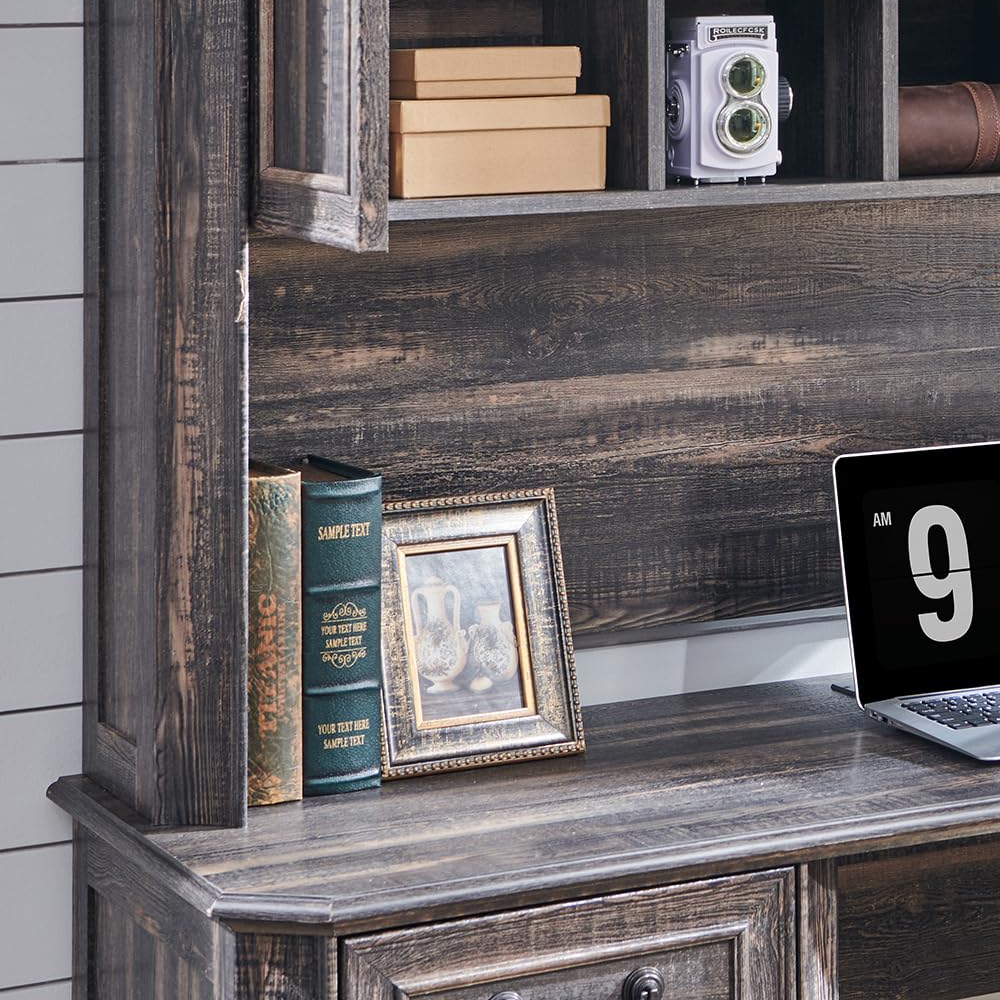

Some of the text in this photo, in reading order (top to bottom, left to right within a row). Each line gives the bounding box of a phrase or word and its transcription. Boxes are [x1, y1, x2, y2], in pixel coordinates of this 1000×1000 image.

[318, 522, 370, 540] SAMPLE TEXT
[873, 511, 892, 528] AM
[907, 504, 974, 642] 9
[321, 621, 367, 635] YOUR TEXT HERE
[325, 635, 362, 648] SAMPLE TEXT
[318, 719, 370, 735] YOUR TEXT HERE
[324, 735, 365, 749] SAMPLE TEXT
